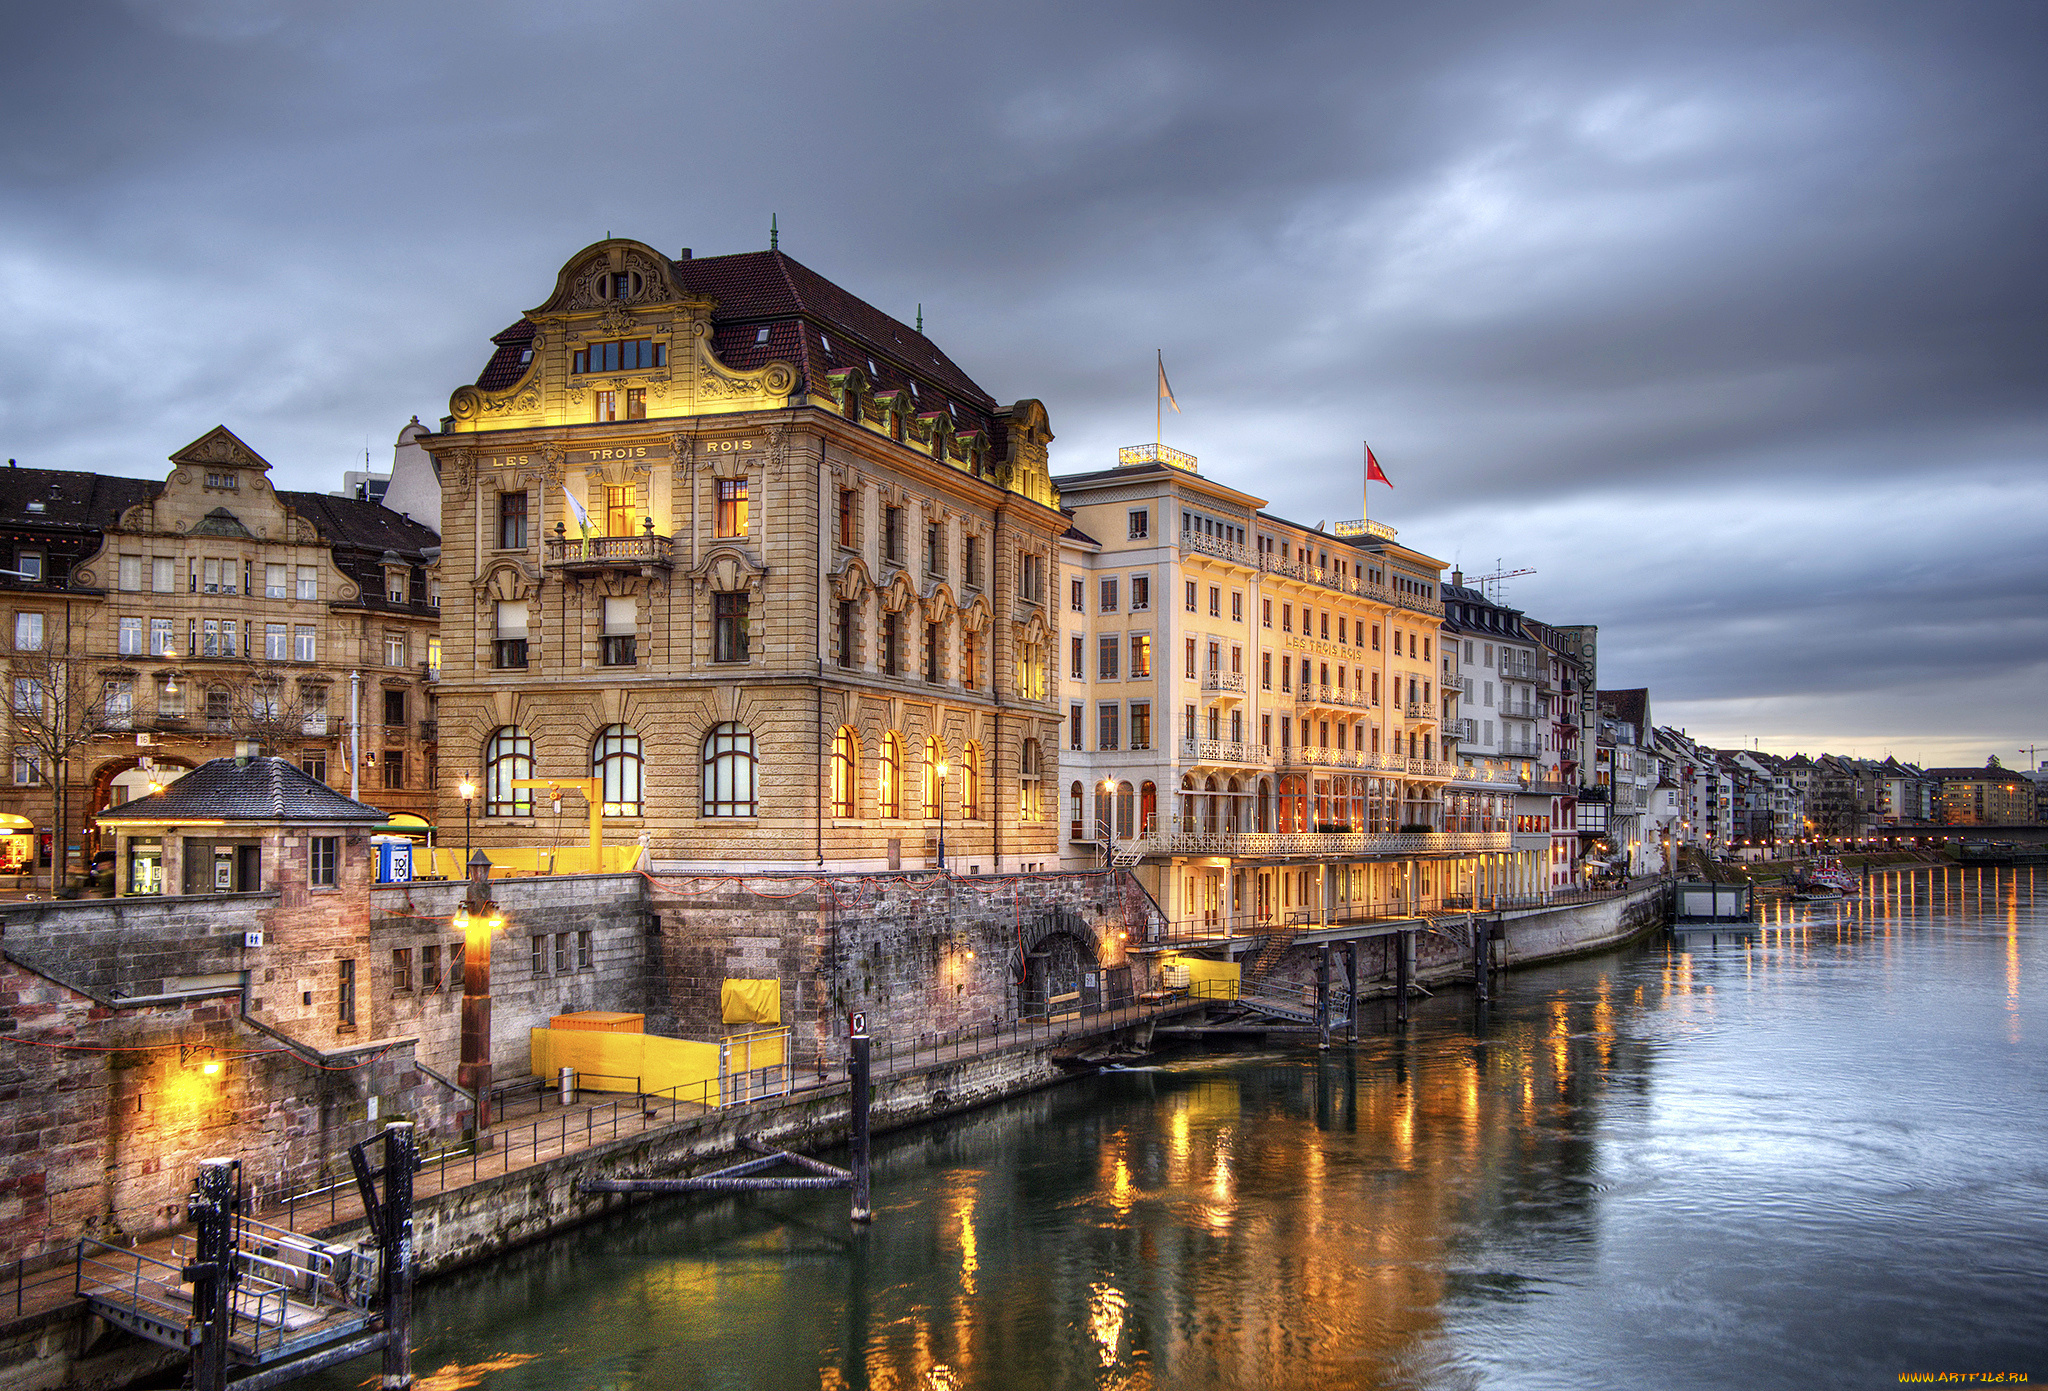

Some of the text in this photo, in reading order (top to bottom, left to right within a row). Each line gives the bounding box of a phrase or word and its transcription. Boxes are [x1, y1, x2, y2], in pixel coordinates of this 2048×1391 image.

[493, 440, 753, 467] LES TROIS ROIS
[1286, 635, 1362, 661] LES TROIS ROIS
[394, 858, 407, 867] TOI
[394, 868, 407, 877] TOI
